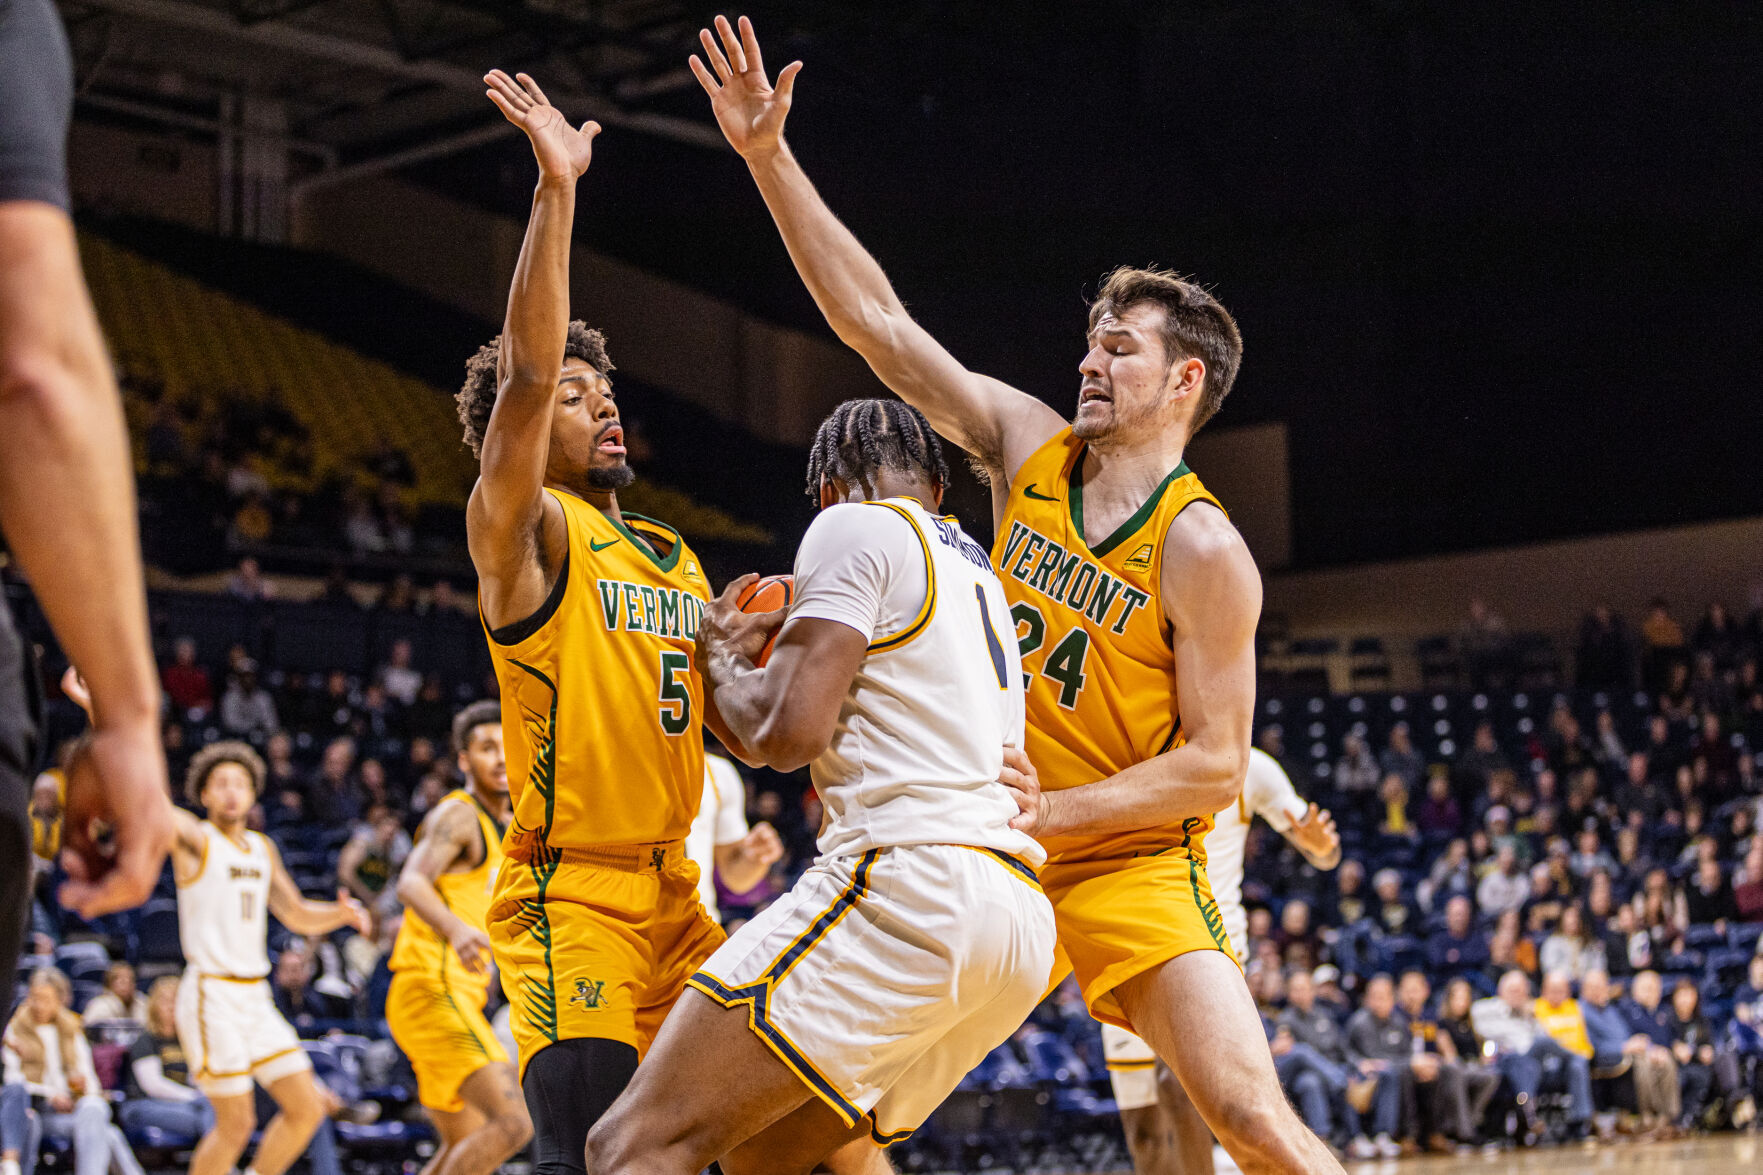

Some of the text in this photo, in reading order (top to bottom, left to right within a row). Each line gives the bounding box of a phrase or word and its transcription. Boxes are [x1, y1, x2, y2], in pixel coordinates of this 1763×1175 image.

[999, 519, 1151, 636] VERMONT
[974, 581, 1008, 691] 1
[1009, 599, 1087, 711] 24
[658, 650, 690, 737] 5
